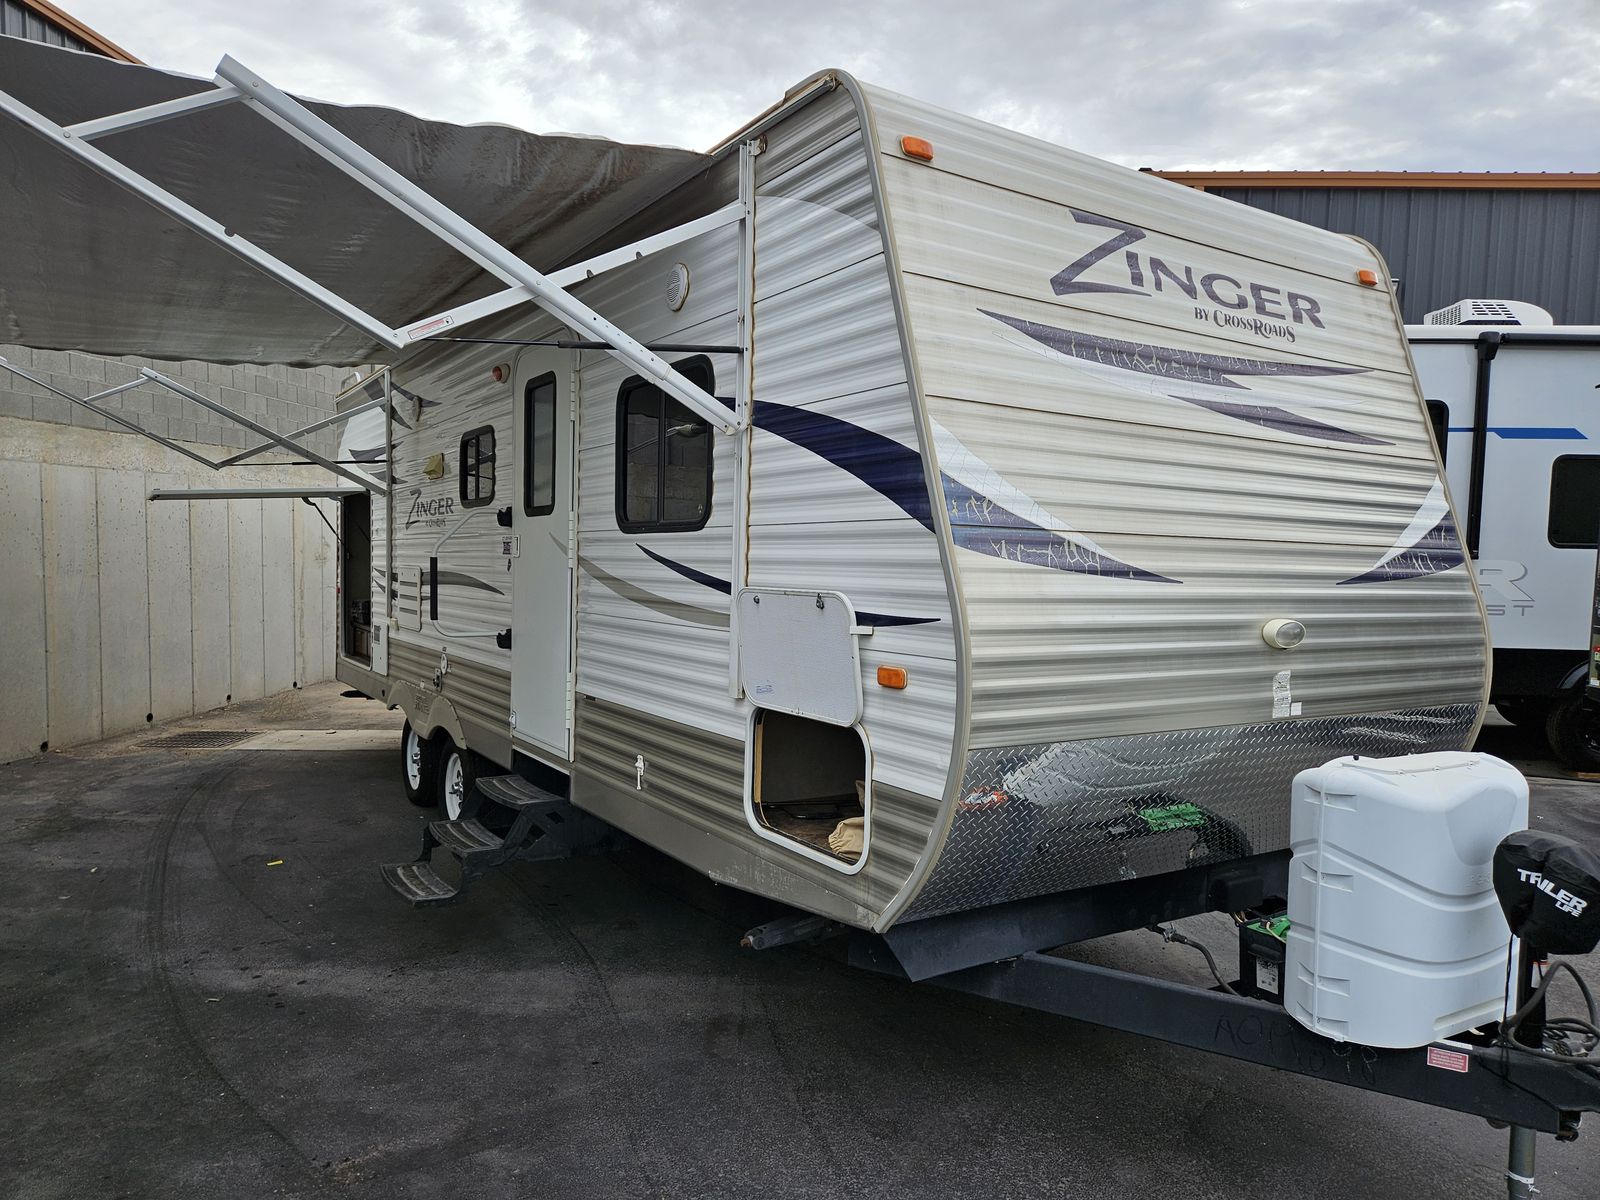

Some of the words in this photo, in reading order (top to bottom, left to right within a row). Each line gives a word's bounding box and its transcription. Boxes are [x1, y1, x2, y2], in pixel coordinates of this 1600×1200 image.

[1049, 209, 1326, 329] ZINGER
[1194, 307, 1210, 322] BY
[405, 488, 454, 530] ZINGER
[1555, 901, 1582, 918] LIFE
